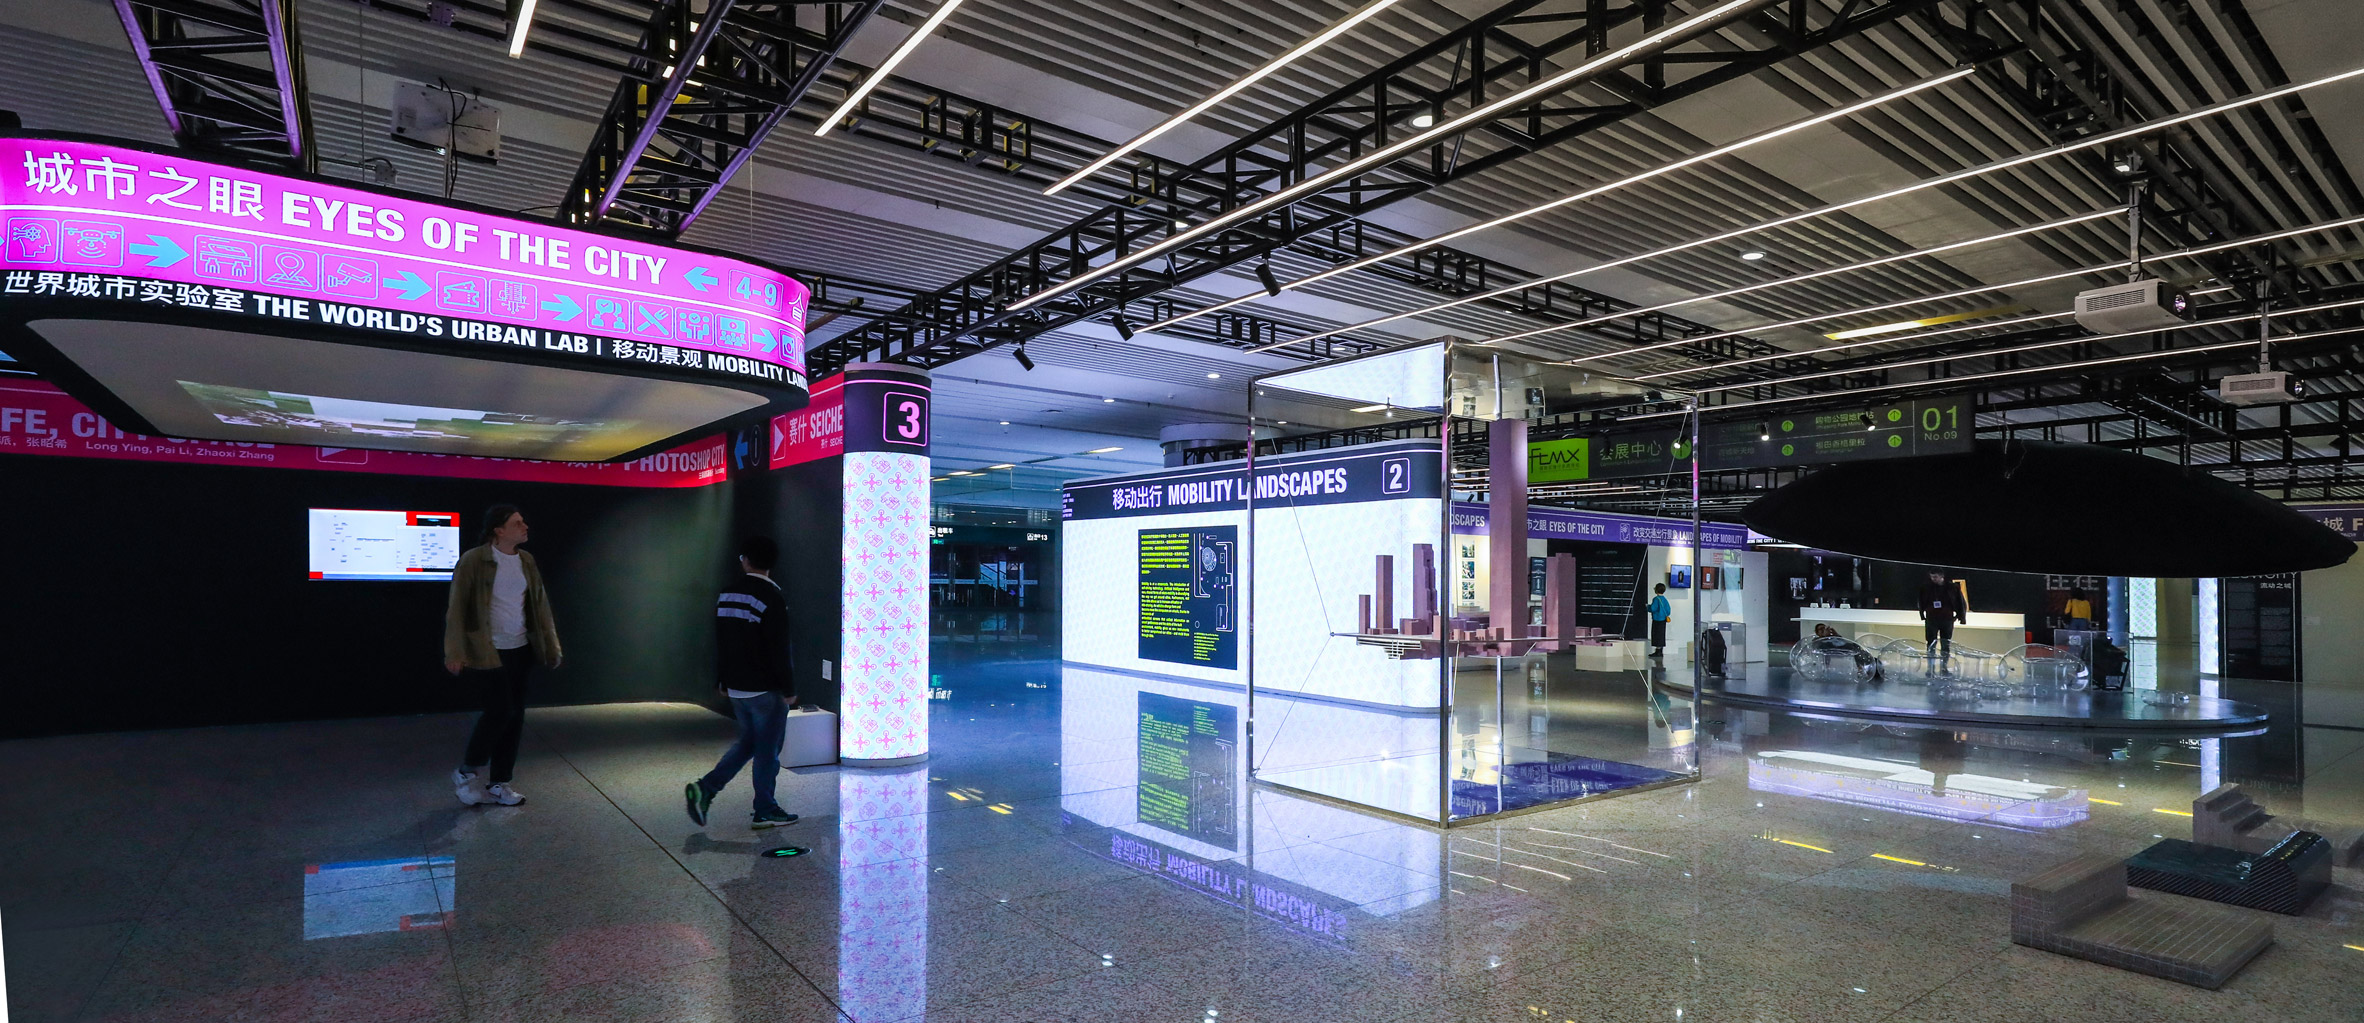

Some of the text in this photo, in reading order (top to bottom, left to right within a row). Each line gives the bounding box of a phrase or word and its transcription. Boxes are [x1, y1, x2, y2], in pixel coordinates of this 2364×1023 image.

[23, 150, 668, 285] 城市之眼 EYES OF THE CITY
[736, 276, 777, 306] 4-9
[4, 270, 245, 313] 世界城市实验室
[252, 293, 310, 320] THE
[319, 302, 443, 336] WORLD'S
[451, 318, 537, 347] URBAN
[544, 331, 589, 354] LAB
[612, 339, 703, 368] 移动景观
[708, 353, 783, 381] MOBILITY
[810, 404, 843, 439] SEICHE
[898, 401, 920, 439] 3
[1922, 405, 1957, 431] 01
[85, 441, 118, 453] Long
[123, 442, 152, 455] Ying,
[156, 445, 176, 455] Pai
[196, 448, 236, 458] Zhaoxi
[239, 450, 275, 462] Zhang
[1389, 464, 1403, 490] 2
[1112, 485, 1162, 511] 移动出行
[1168, 479, 1233, 505] MOBILITY
[1549, 521, 1566, 532] EYES
[1567, 522, 1577, 533] OF
[1577, 523, 1590, 534] THE
[1590, 524, 1605, 535] CITY
[1712, 533, 1719, 542] OF
[1720, 534, 1743, 544] MOBILITY
